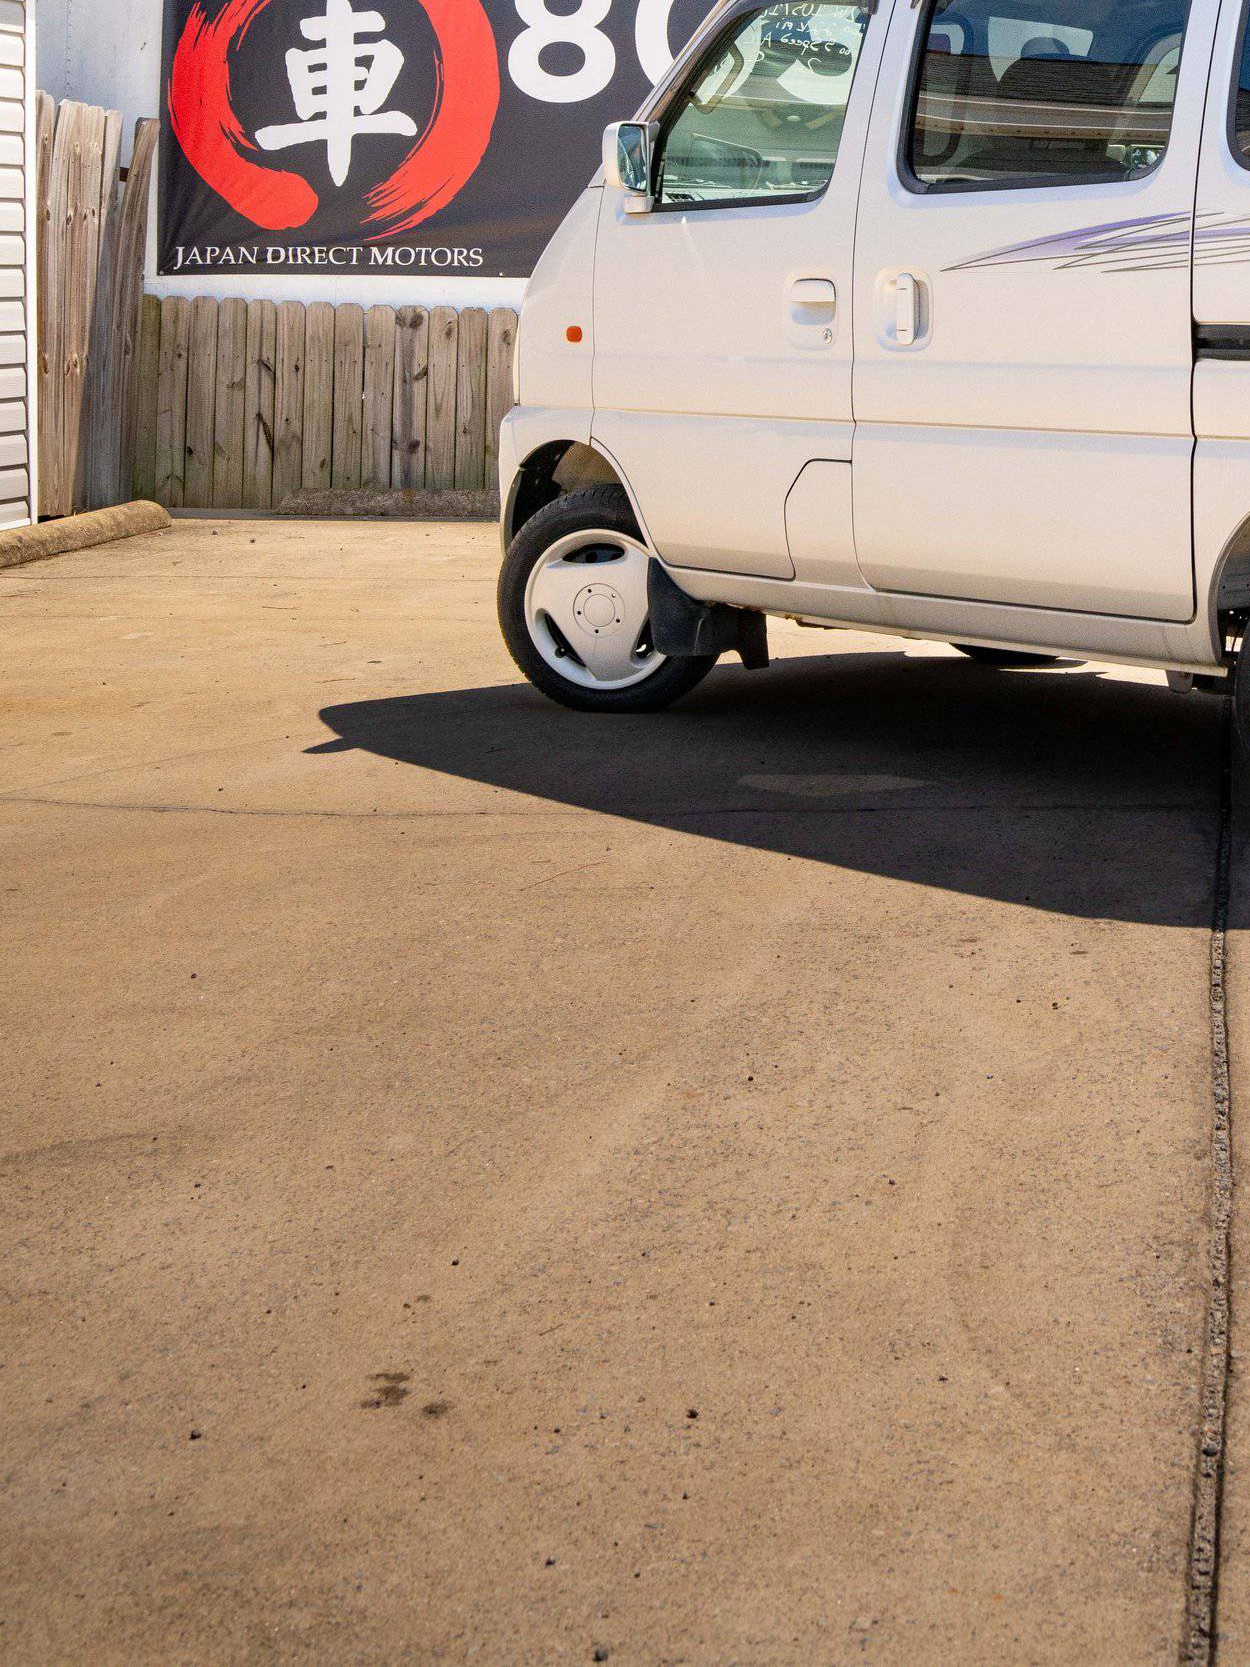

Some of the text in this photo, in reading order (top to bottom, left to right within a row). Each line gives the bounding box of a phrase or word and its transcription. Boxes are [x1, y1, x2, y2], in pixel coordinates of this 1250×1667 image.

[173, 246, 484, 270] JAPAN DIRECT MOTORS
